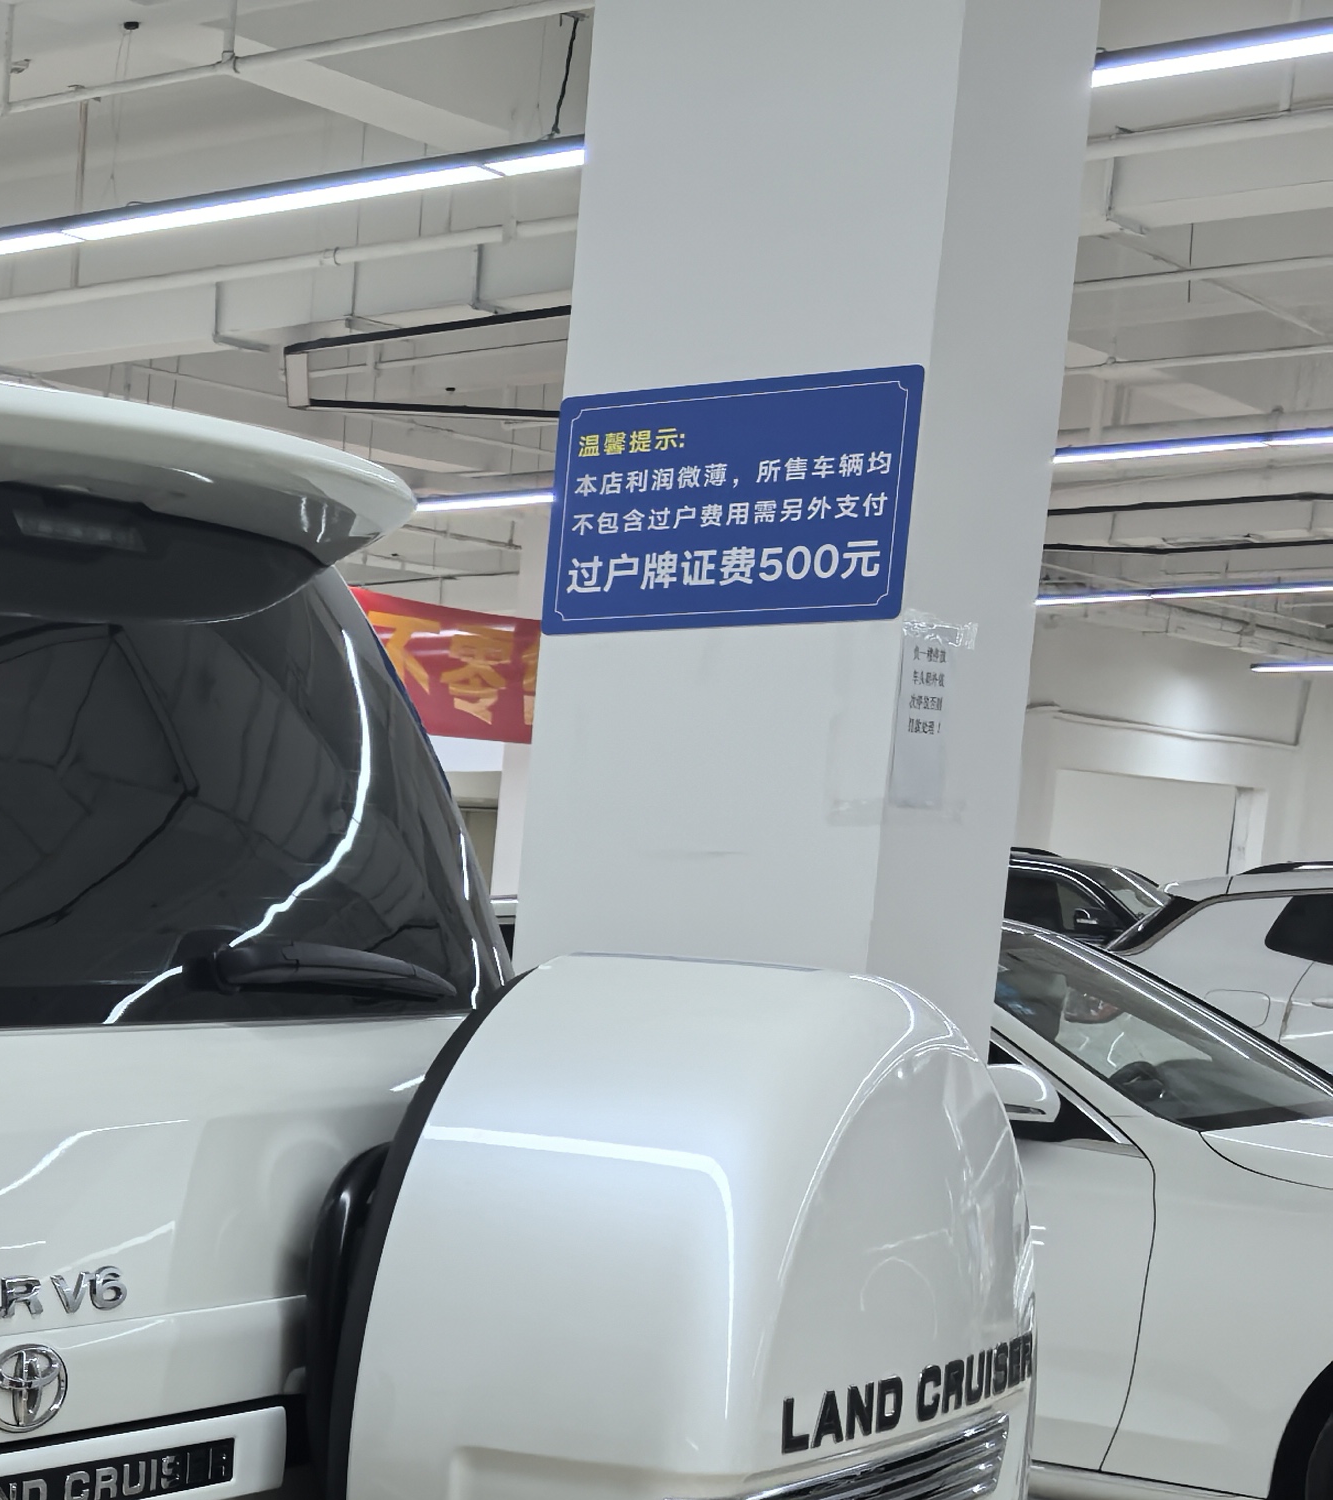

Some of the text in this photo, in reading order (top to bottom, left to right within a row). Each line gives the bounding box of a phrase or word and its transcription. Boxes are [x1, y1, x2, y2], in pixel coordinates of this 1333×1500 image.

[577, 427, 686, 458] 温馨提示:
[571, 492, 888, 536] 不包含过户费用需另外支付
[566, 539, 882, 594] 过户牌证费500元
[50, 1265, 128, 1314] V6
[781, 1330, 1033, 1455] LAND CRUISER
